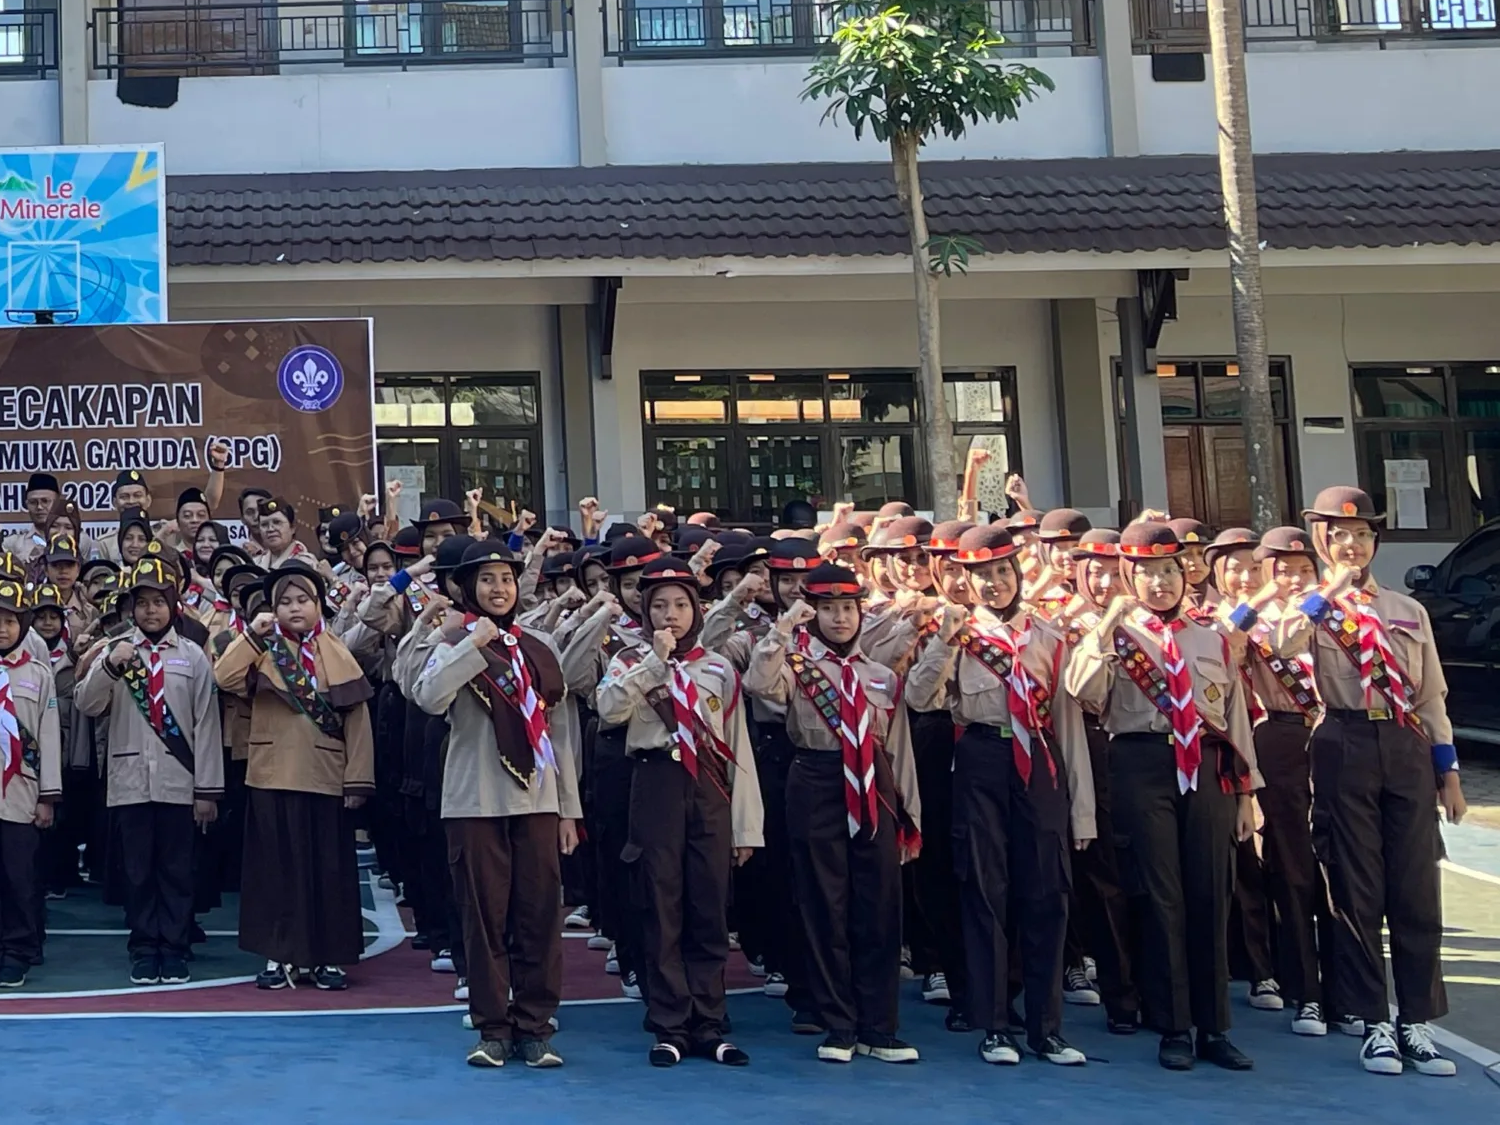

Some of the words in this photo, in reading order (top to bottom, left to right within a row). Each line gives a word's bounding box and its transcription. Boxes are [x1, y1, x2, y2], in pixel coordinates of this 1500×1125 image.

[46, 176, 73, 199] Le
[0, 197, 101, 219] Minerale
[85, 436, 199, 472] GARUDA
[62, 479, 116, 512] 202
